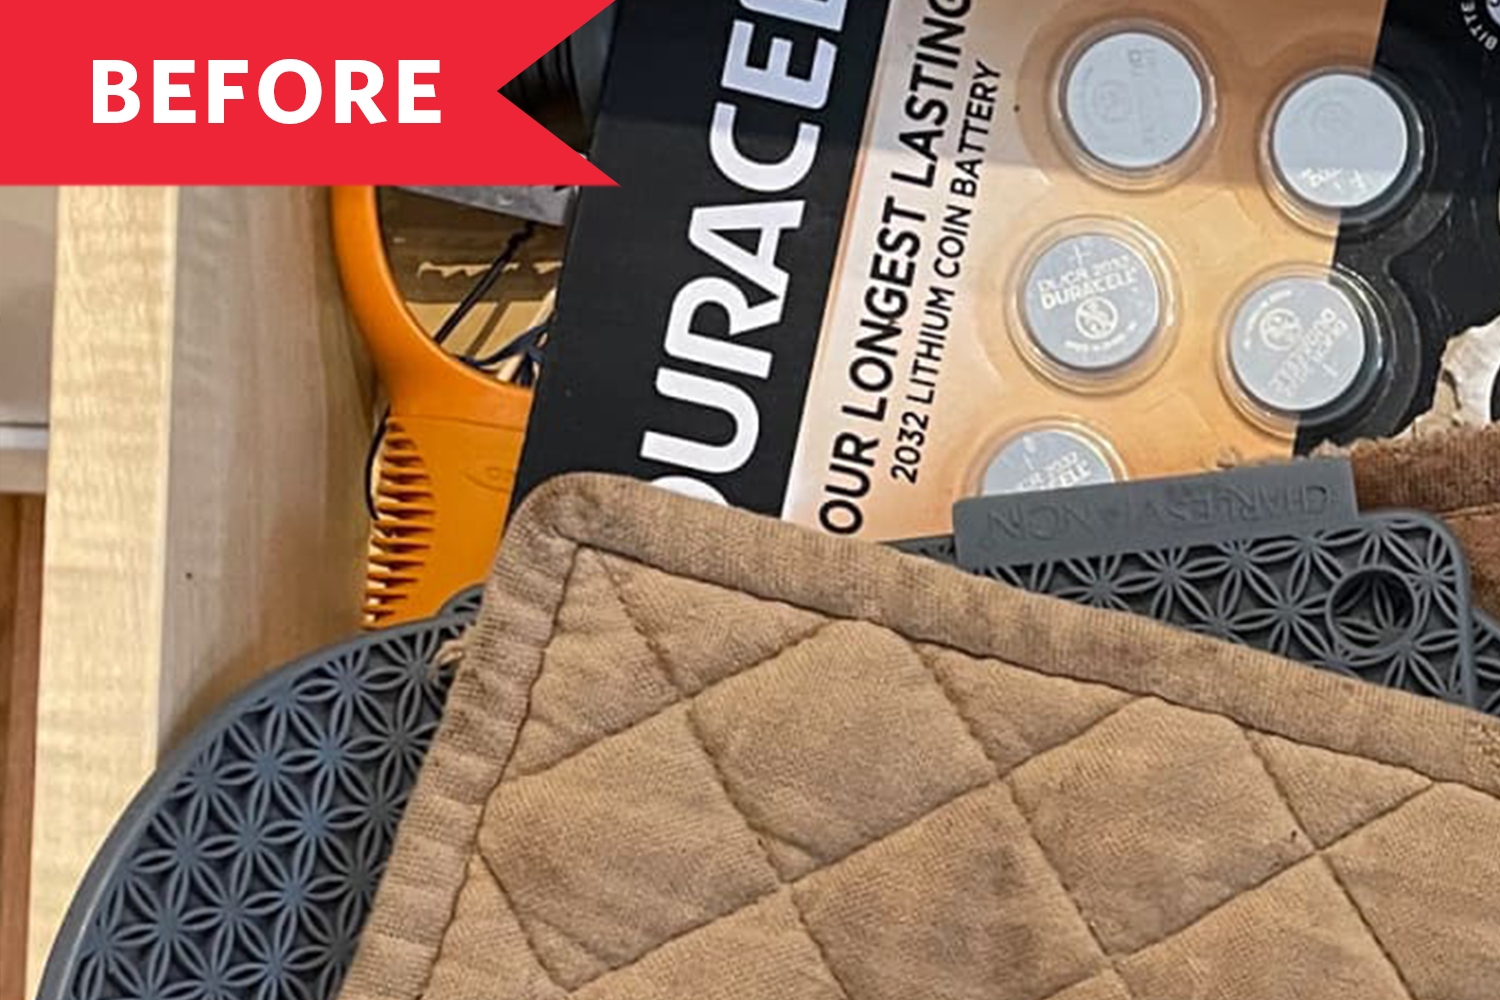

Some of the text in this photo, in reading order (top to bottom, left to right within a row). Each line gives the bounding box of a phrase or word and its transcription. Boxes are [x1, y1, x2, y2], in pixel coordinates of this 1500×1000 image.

[640, 0, 848, 507] URACEL
[819, 0, 972, 535] OUR LONGEST LASTING
[890, 60, 1001, 484] 2032 LITHIUM COIN BATTERY
